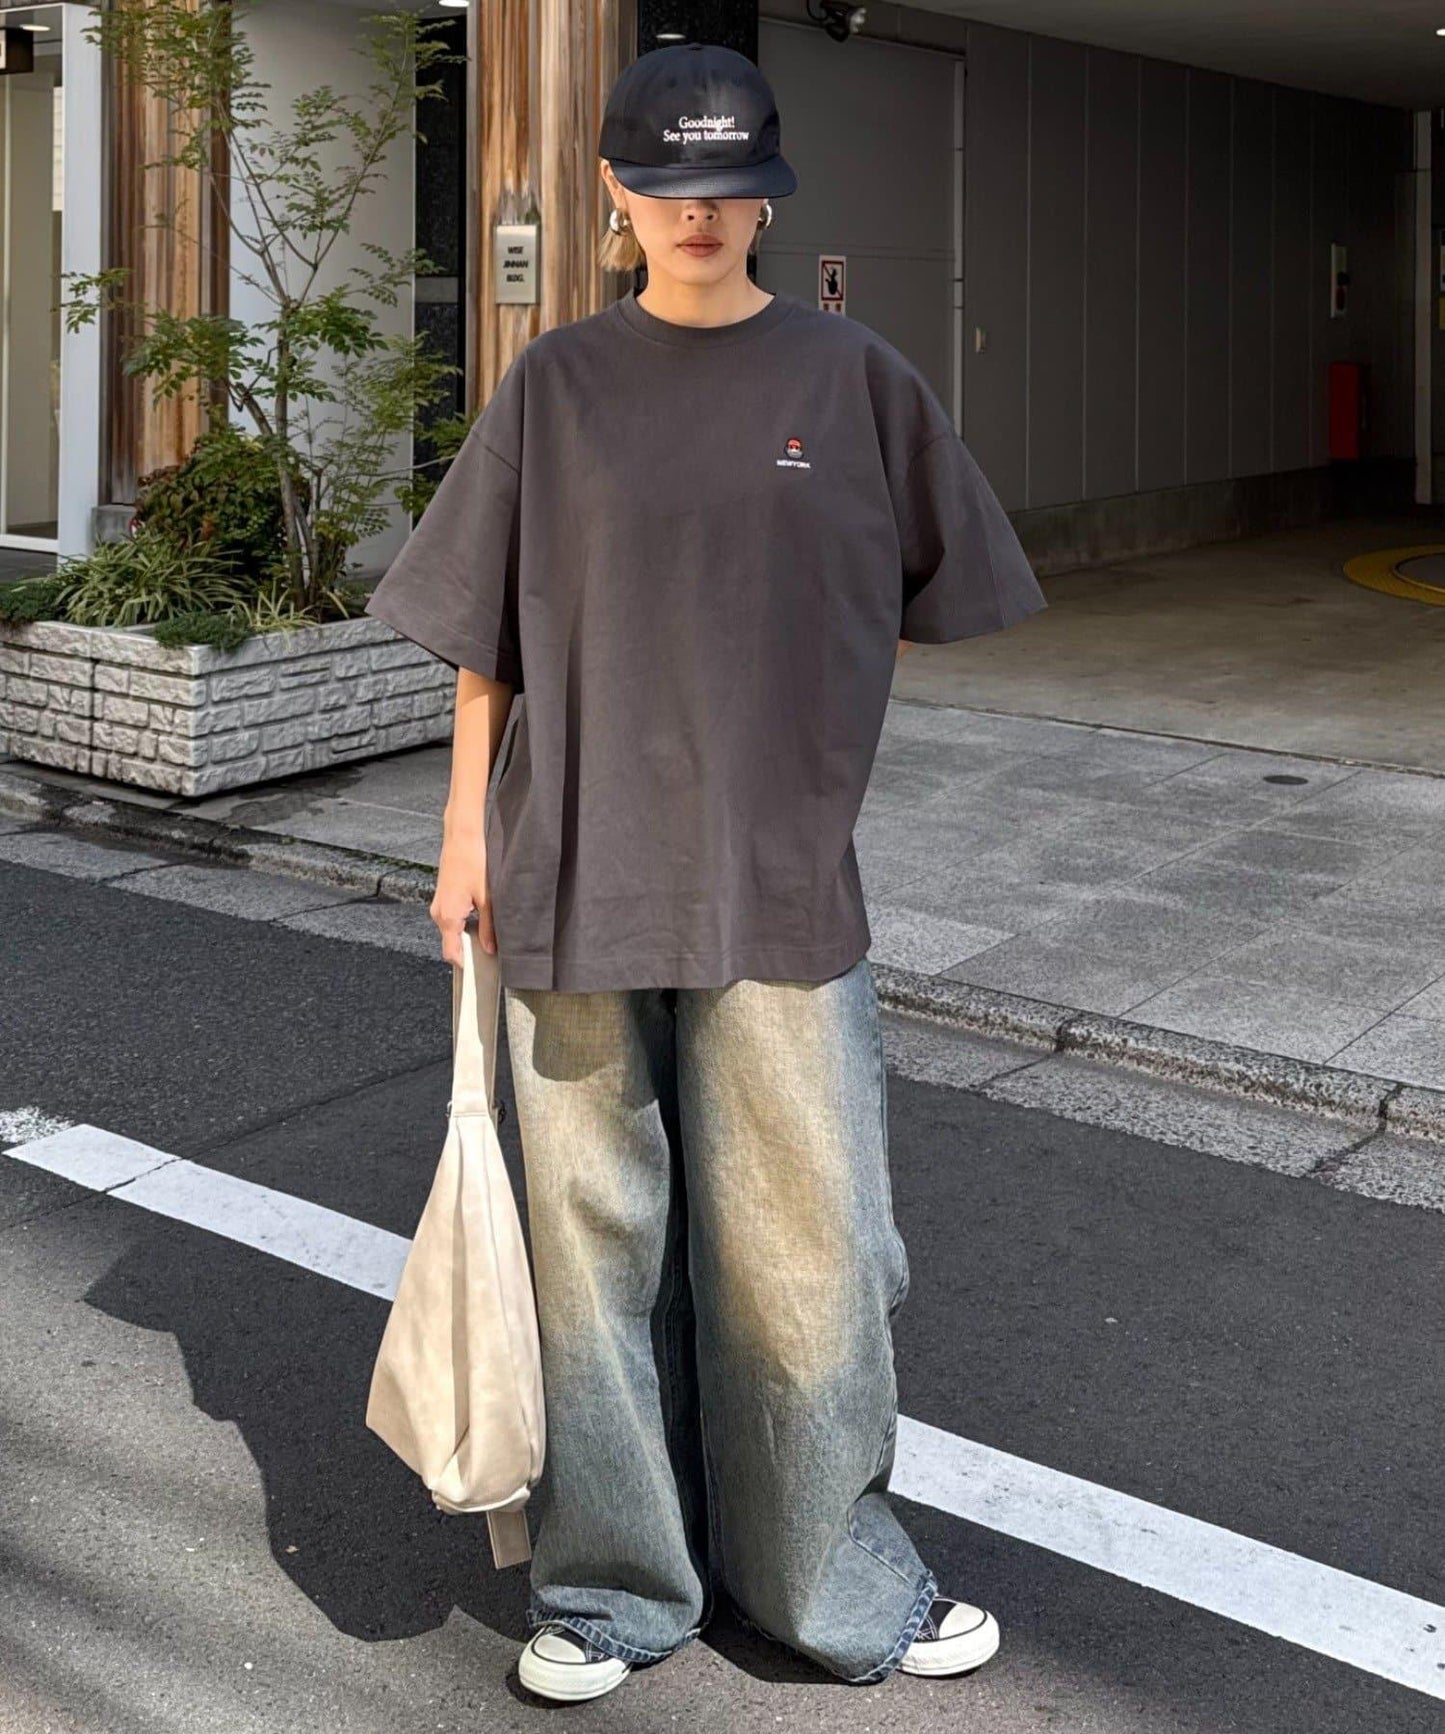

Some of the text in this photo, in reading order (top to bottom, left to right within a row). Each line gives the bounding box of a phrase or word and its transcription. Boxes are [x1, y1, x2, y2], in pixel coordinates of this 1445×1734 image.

[678, 115, 735, 131] Goodnight!
[663, 129, 750, 145] See you tomorrow
